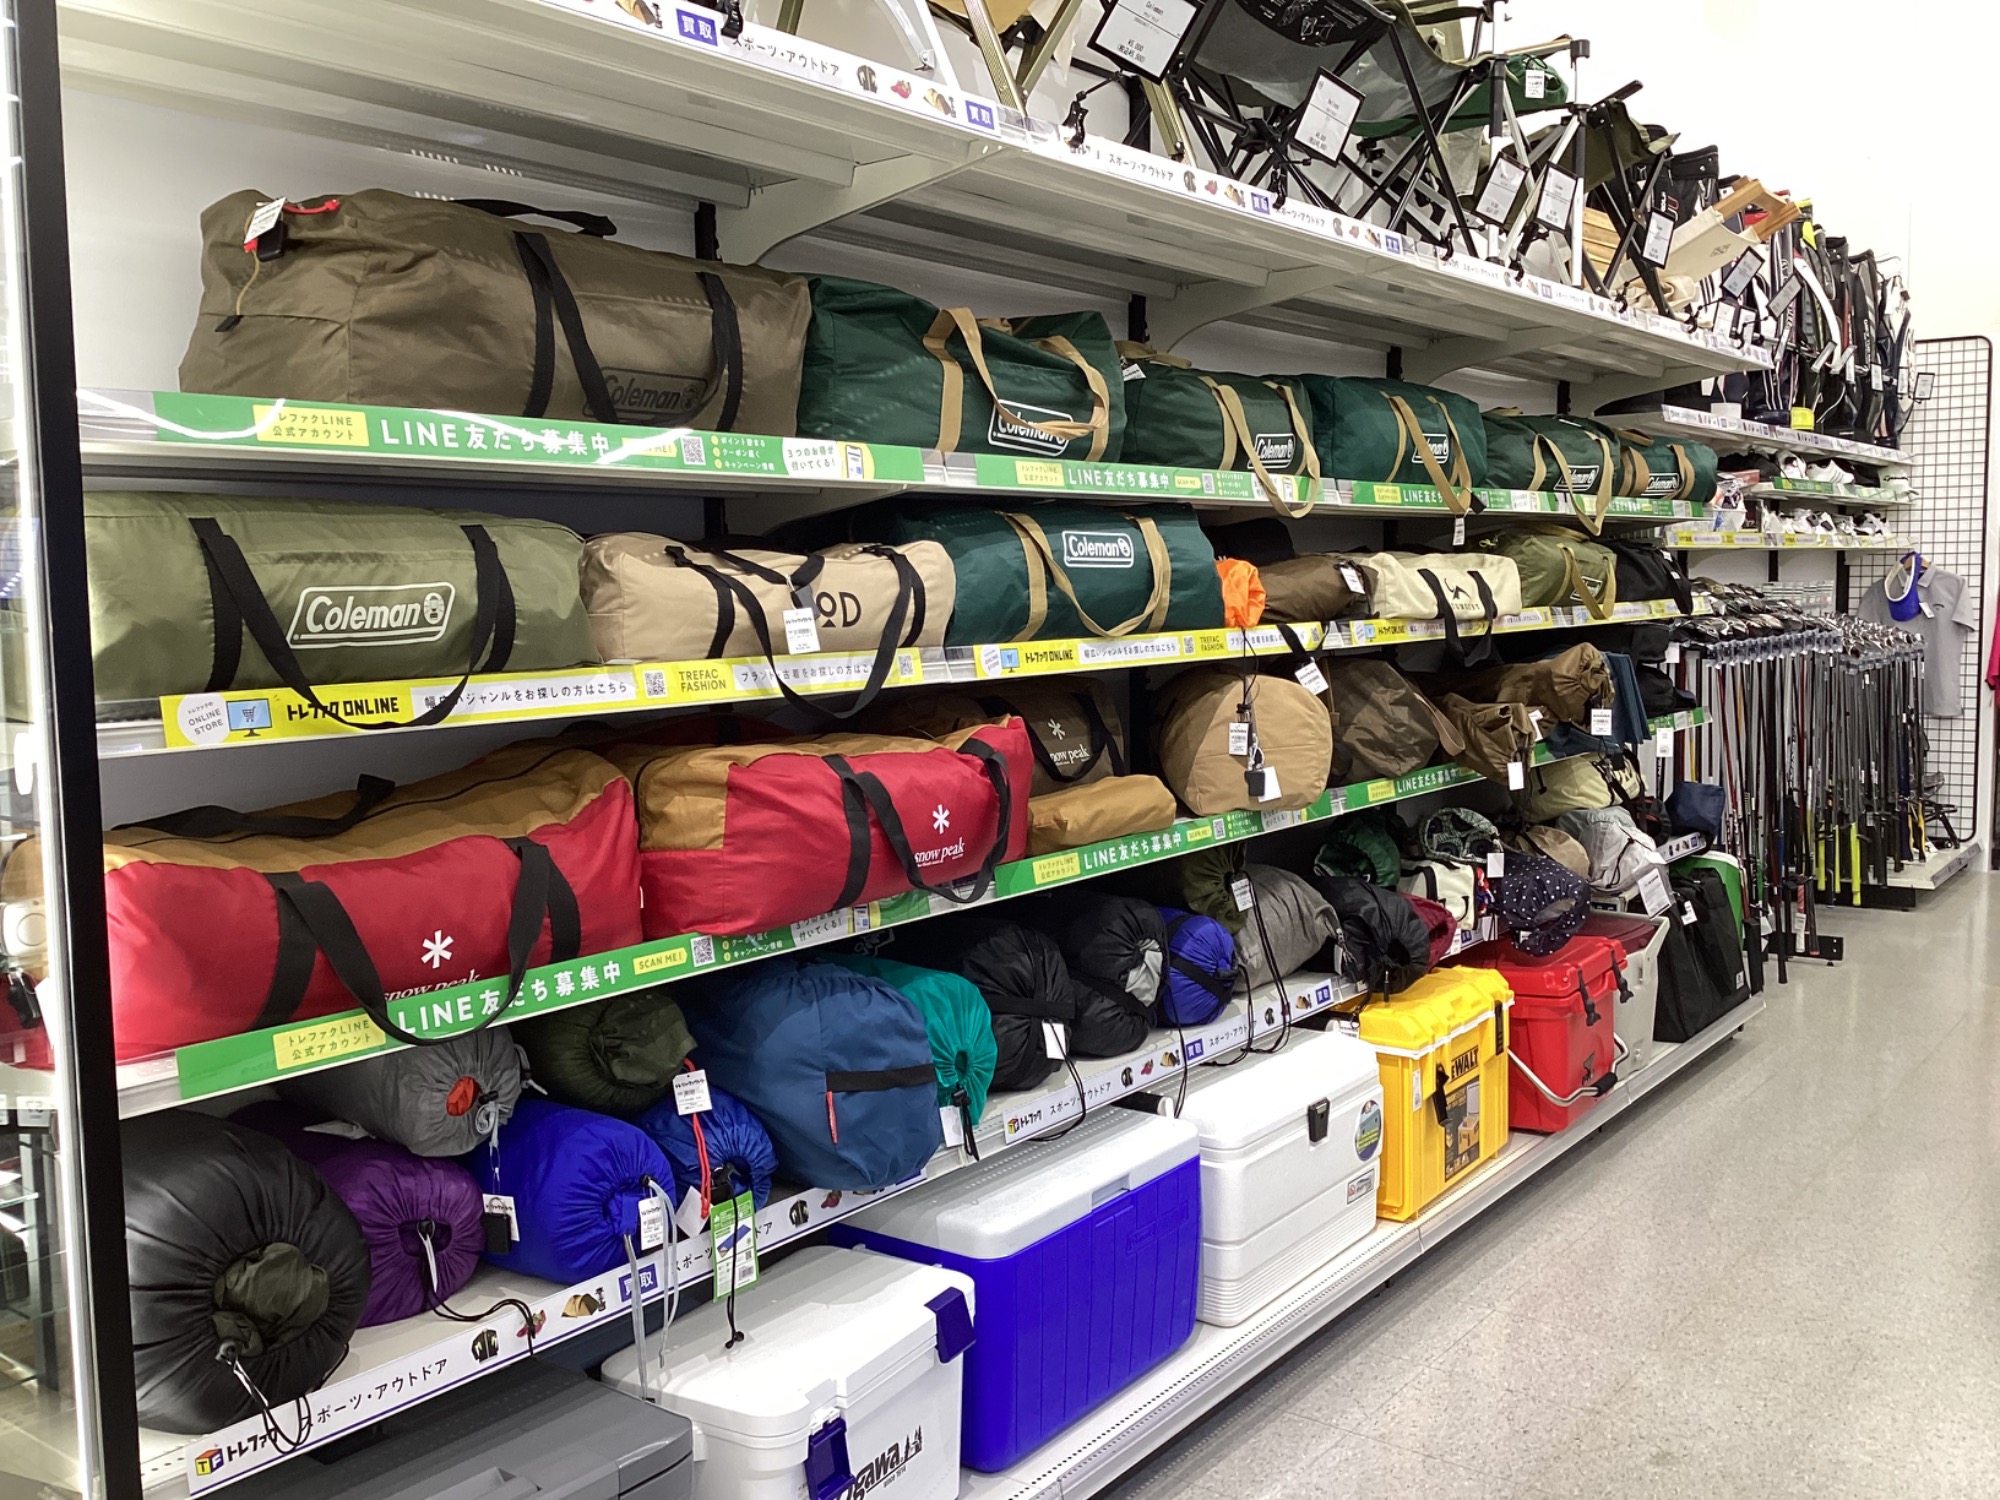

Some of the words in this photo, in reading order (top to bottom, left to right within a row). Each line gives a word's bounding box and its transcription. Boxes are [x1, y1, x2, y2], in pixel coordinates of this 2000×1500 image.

[680, 14, 711, 39] 買取
[732, 37, 839, 76] スポーツ・アウトドア
[970, 104, 992, 125] 買取
[277, 411, 353, 427] レファクLINE
[273, 426, 354, 441] 公式アカウント
[1068, 468, 1170, 490] LINE友だち募集中
[1069, 535, 1120, 558] Coleman
[306, 595, 421, 632] Coleman
[816, 591, 862, 628] OD
[679, 669, 719, 681] TREFAC
[680, 679, 728, 692] FASHION
[188, 707, 222, 727] ONLINE
[194, 718, 224, 735] STORE
[1050, 749, 1067, 761] now
[1068, 744, 1090, 764] peak
[914, 848, 940, 862] snow
[941, 836, 966, 865] peak
[1084, 832, 1182, 870] LINE友だち募集中
[638, 956, 664, 972] SCAN
[664, 952, 683, 967] ME!
[288, 1019, 371, 1047] トレファクLINE
[291, 1034, 372, 1061] 公式アカウント
[1451, 1048, 1478, 1079] EWALT
[1049, 1081, 1111, 1116] スポーツ・ウトドア
